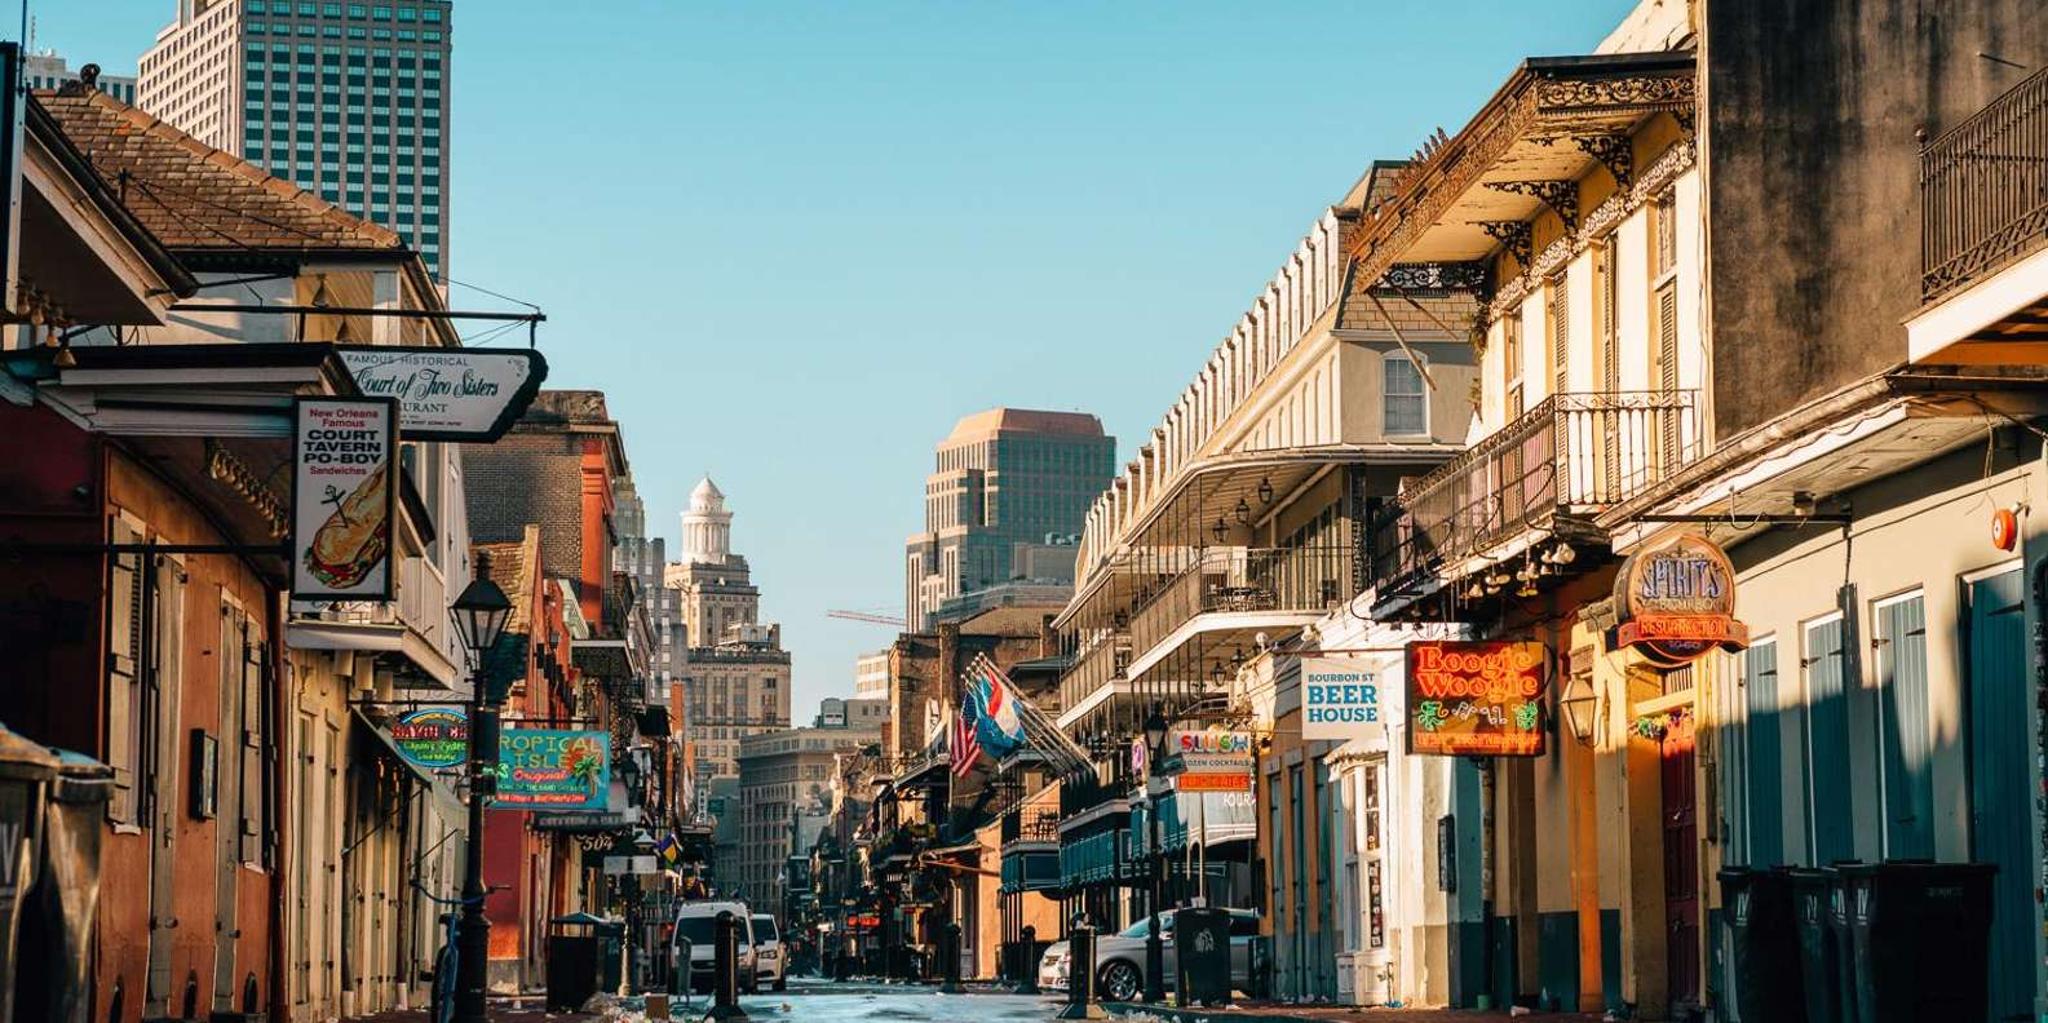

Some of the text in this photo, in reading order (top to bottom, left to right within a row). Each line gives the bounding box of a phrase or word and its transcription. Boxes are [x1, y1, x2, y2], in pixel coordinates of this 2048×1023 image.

[347, 354, 468, 366] FAMOUS HISTORICAL
[397, 372, 417, 400] of
[415, 368, 451, 401] Two
[454, 368, 499, 398] Sisters
[310, 408, 378, 418] New Orleans
[400, 402, 448, 413] URANT
[323, 418, 365, 428] Famous
[308, 429, 379, 440] COURT
[303, 441, 382, 452] TAVERN
[304, 453, 382, 464] PO-BOY
[310, 465, 367, 475] Sandwiches
[1641, 558, 1725, 599] SPIRITS
[1417, 646, 1533, 679] Boogie
[1308, 673, 1375, 682] BOURBON ST
[1416, 671, 1538, 703] Woogie
[1308, 685, 1377, 705] BEER
[1308, 707, 1377, 723] HOUSE
[499, 736, 602, 753] ROPICAL
[513, 752, 569, 769] ISLE
[513, 768, 567, 783] Original
[583, 836, 614, 850] 504
